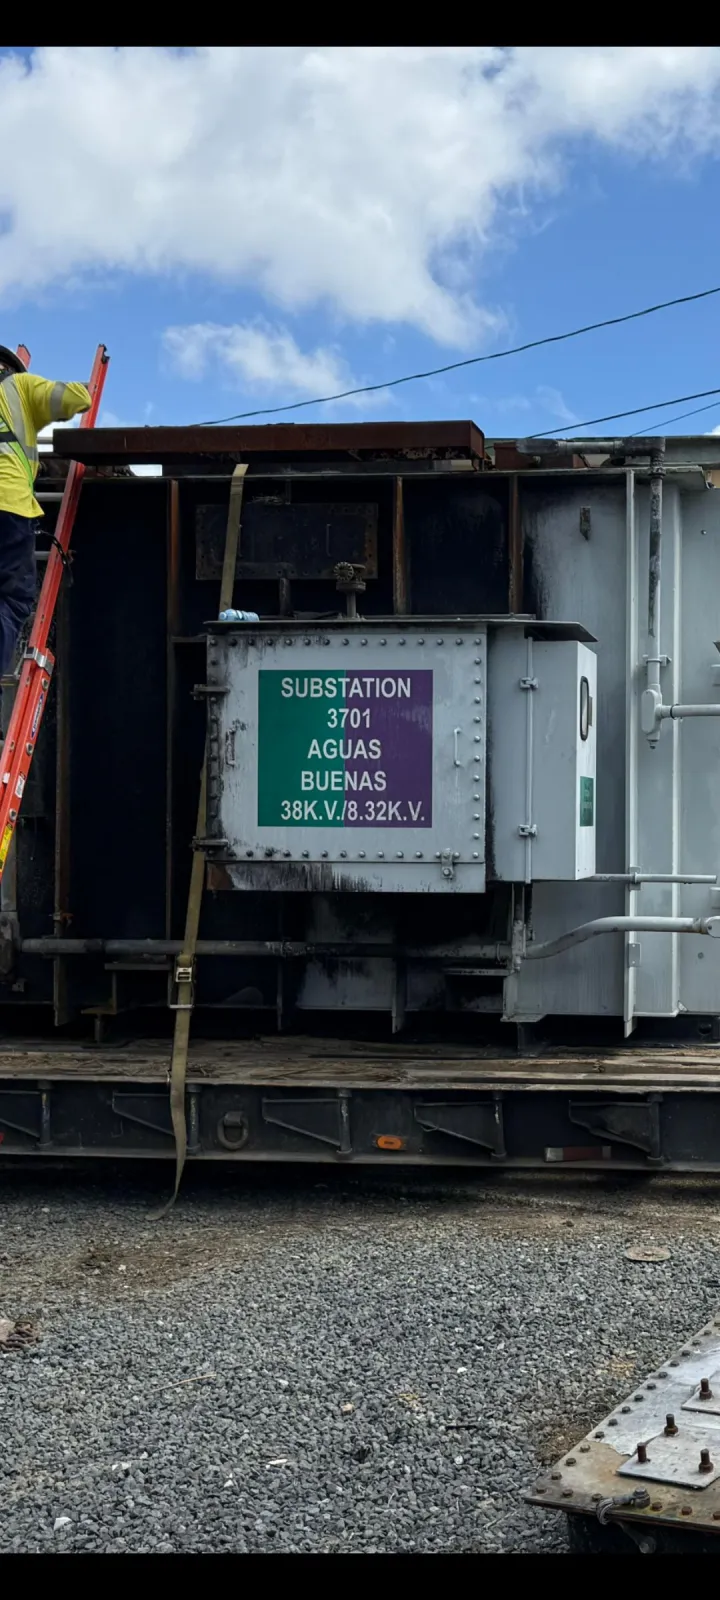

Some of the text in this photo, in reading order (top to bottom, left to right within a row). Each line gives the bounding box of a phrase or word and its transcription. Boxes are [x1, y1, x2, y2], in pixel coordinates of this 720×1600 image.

[281, 677, 411, 698] SUBSTATION
[327, 708, 371, 728] 3701
[307, 739, 382, 759] AGUAS
[301, 771, 387, 791] BUENAS
[281, 800, 425, 821] 38K.V./8.32K.V.
